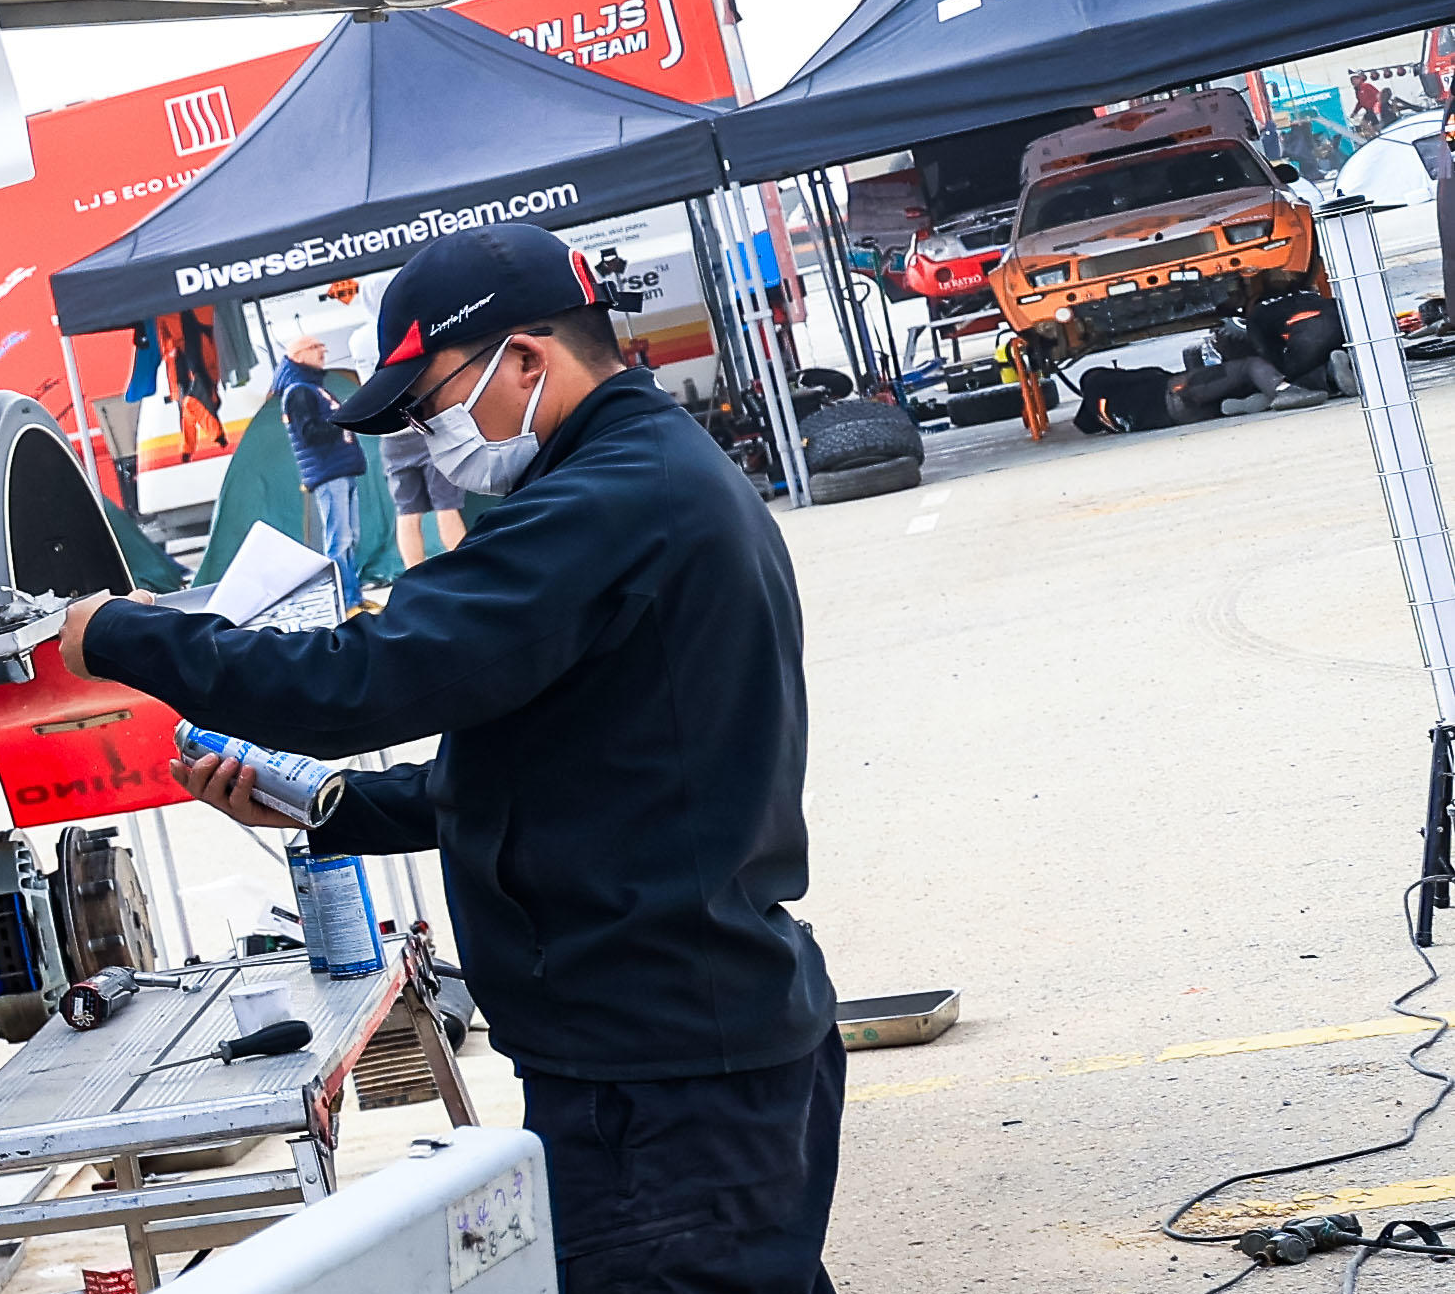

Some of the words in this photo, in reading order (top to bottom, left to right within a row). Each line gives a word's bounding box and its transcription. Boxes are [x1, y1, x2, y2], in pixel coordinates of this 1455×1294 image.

[578, 31, 648, 65] TEAM
[73, 190, 118, 213] LJS
[121, 178, 164, 201] ECO
[175, 183, 579, 297] DiverseExtremeTeam.com
